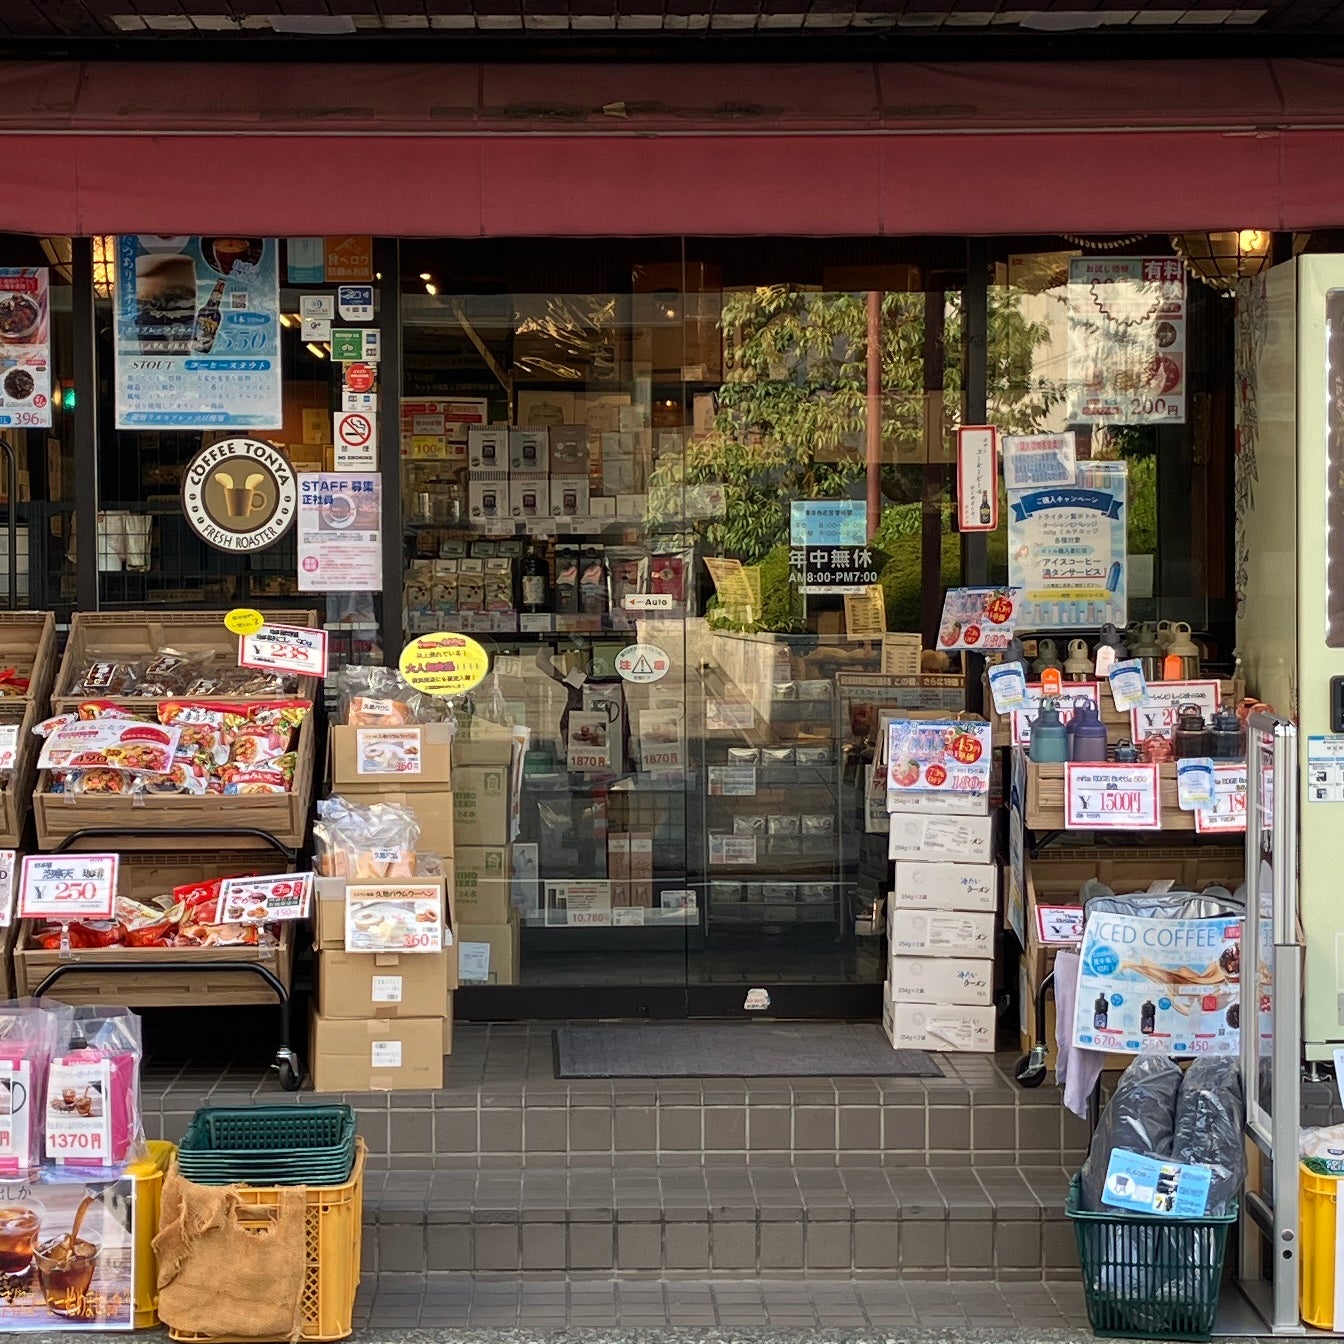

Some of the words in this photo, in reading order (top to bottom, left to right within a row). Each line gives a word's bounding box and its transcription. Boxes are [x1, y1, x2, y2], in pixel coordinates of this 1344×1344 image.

[327, 254, 369, 266] 食べログ
[1144, 260, 1182, 280] 有料
[132, 360, 175, 370] STOUT
[1130, 398, 1179, 416] 200円
[190, 443, 236, 486] COFFEE
[243, 443, 290, 487] TONYA
[302, 481, 348, 492] STAFF
[302, 494, 334, 505] 正社員
[202, 523, 233, 548] FRESH
[236, 525, 278, 549] ROASTER
[788, 549, 873, 569] 年中無休
[1043, 557, 1101, 566] アイスコーヒー
[789, 571, 878, 583] AM8:00-PM7:00
[271, 644, 309, 661] 238
[571, 756, 605, 766] 1870円
[1099, 792, 1141, 813] 1500円
[55, 882, 96, 900] 250
[966, 886, 990, 894] ラーメン
[1094, 922, 1136, 944] ICED
[1143, 927, 1217, 948] COFFEE
[963, 979, 987, 988] ラーメン
[48, 1133, 102, 1149] 1370円
